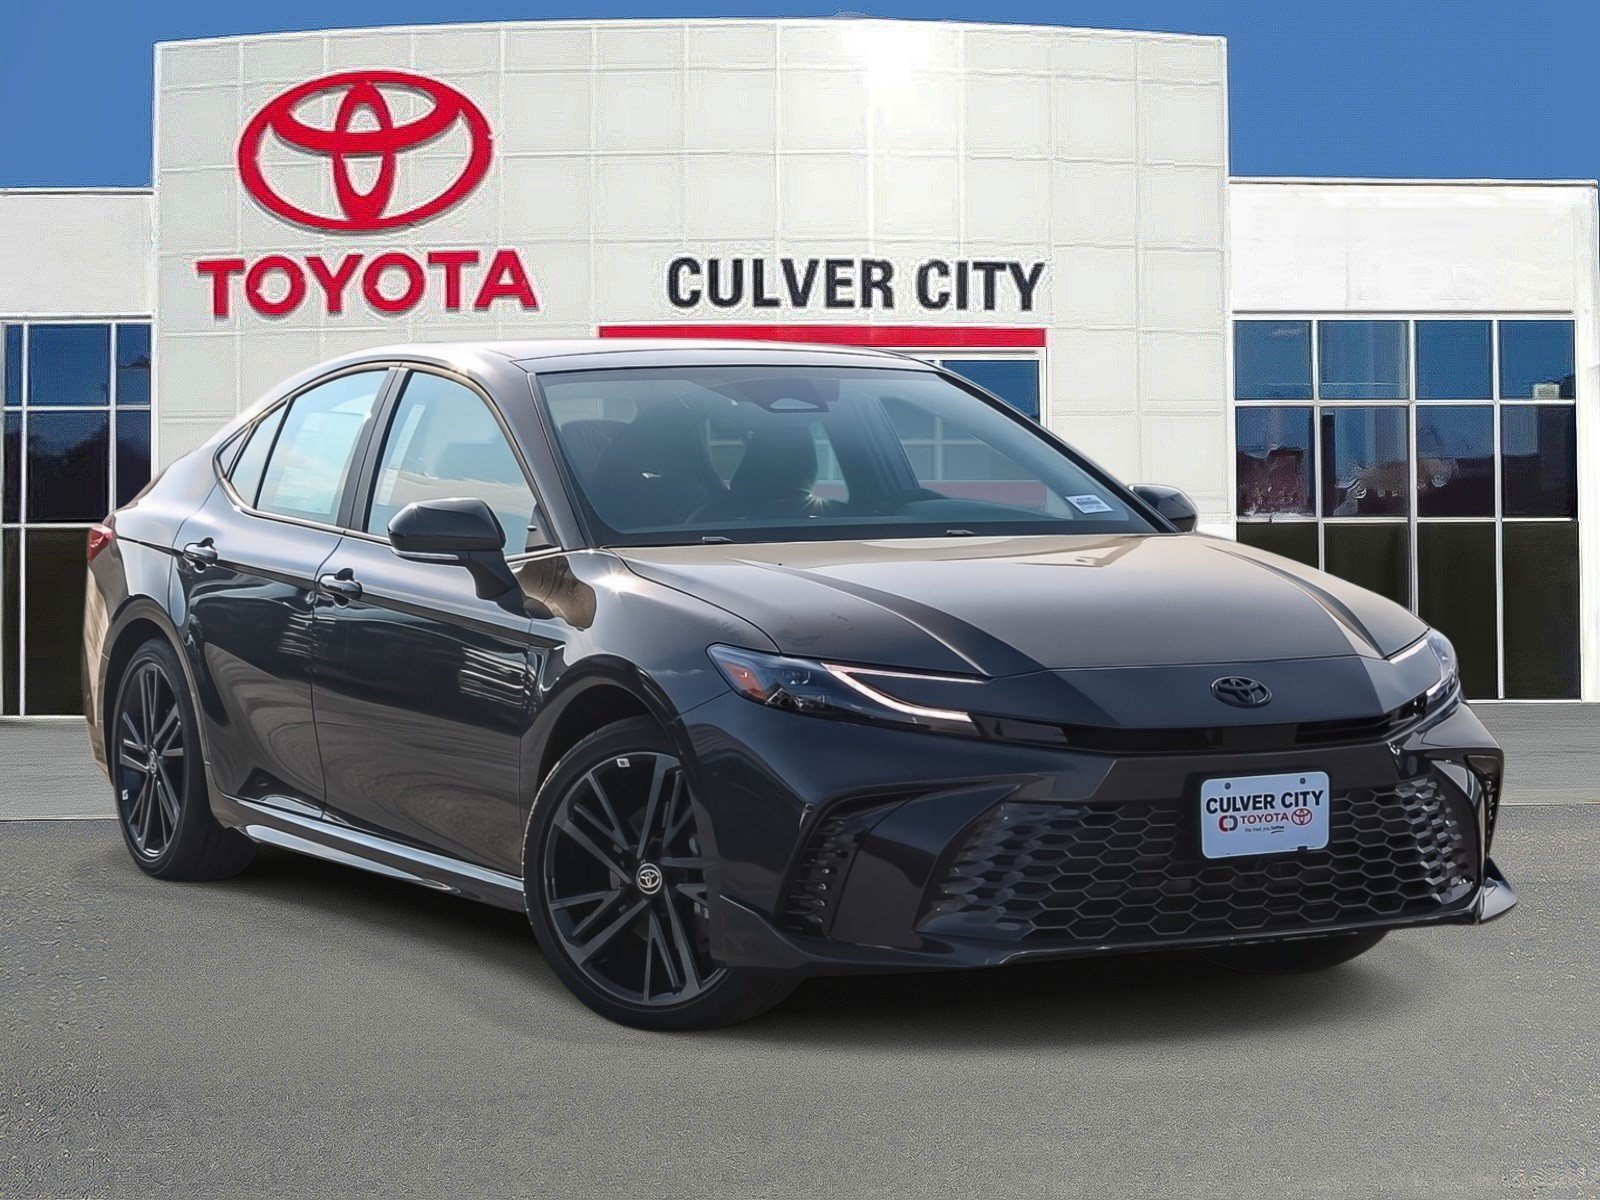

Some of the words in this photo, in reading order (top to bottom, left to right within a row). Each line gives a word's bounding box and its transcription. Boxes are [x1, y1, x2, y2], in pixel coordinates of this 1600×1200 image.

[196, 249, 538, 317] TOYOTA
[667, 257, 895, 308] CULVER
[915, 259, 1045, 311] CITY
[1206, 794, 1275, 814] CULVER
[1281, 790, 1324, 808] CITY
[1240, 813, 1289, 825] TOYOTA
